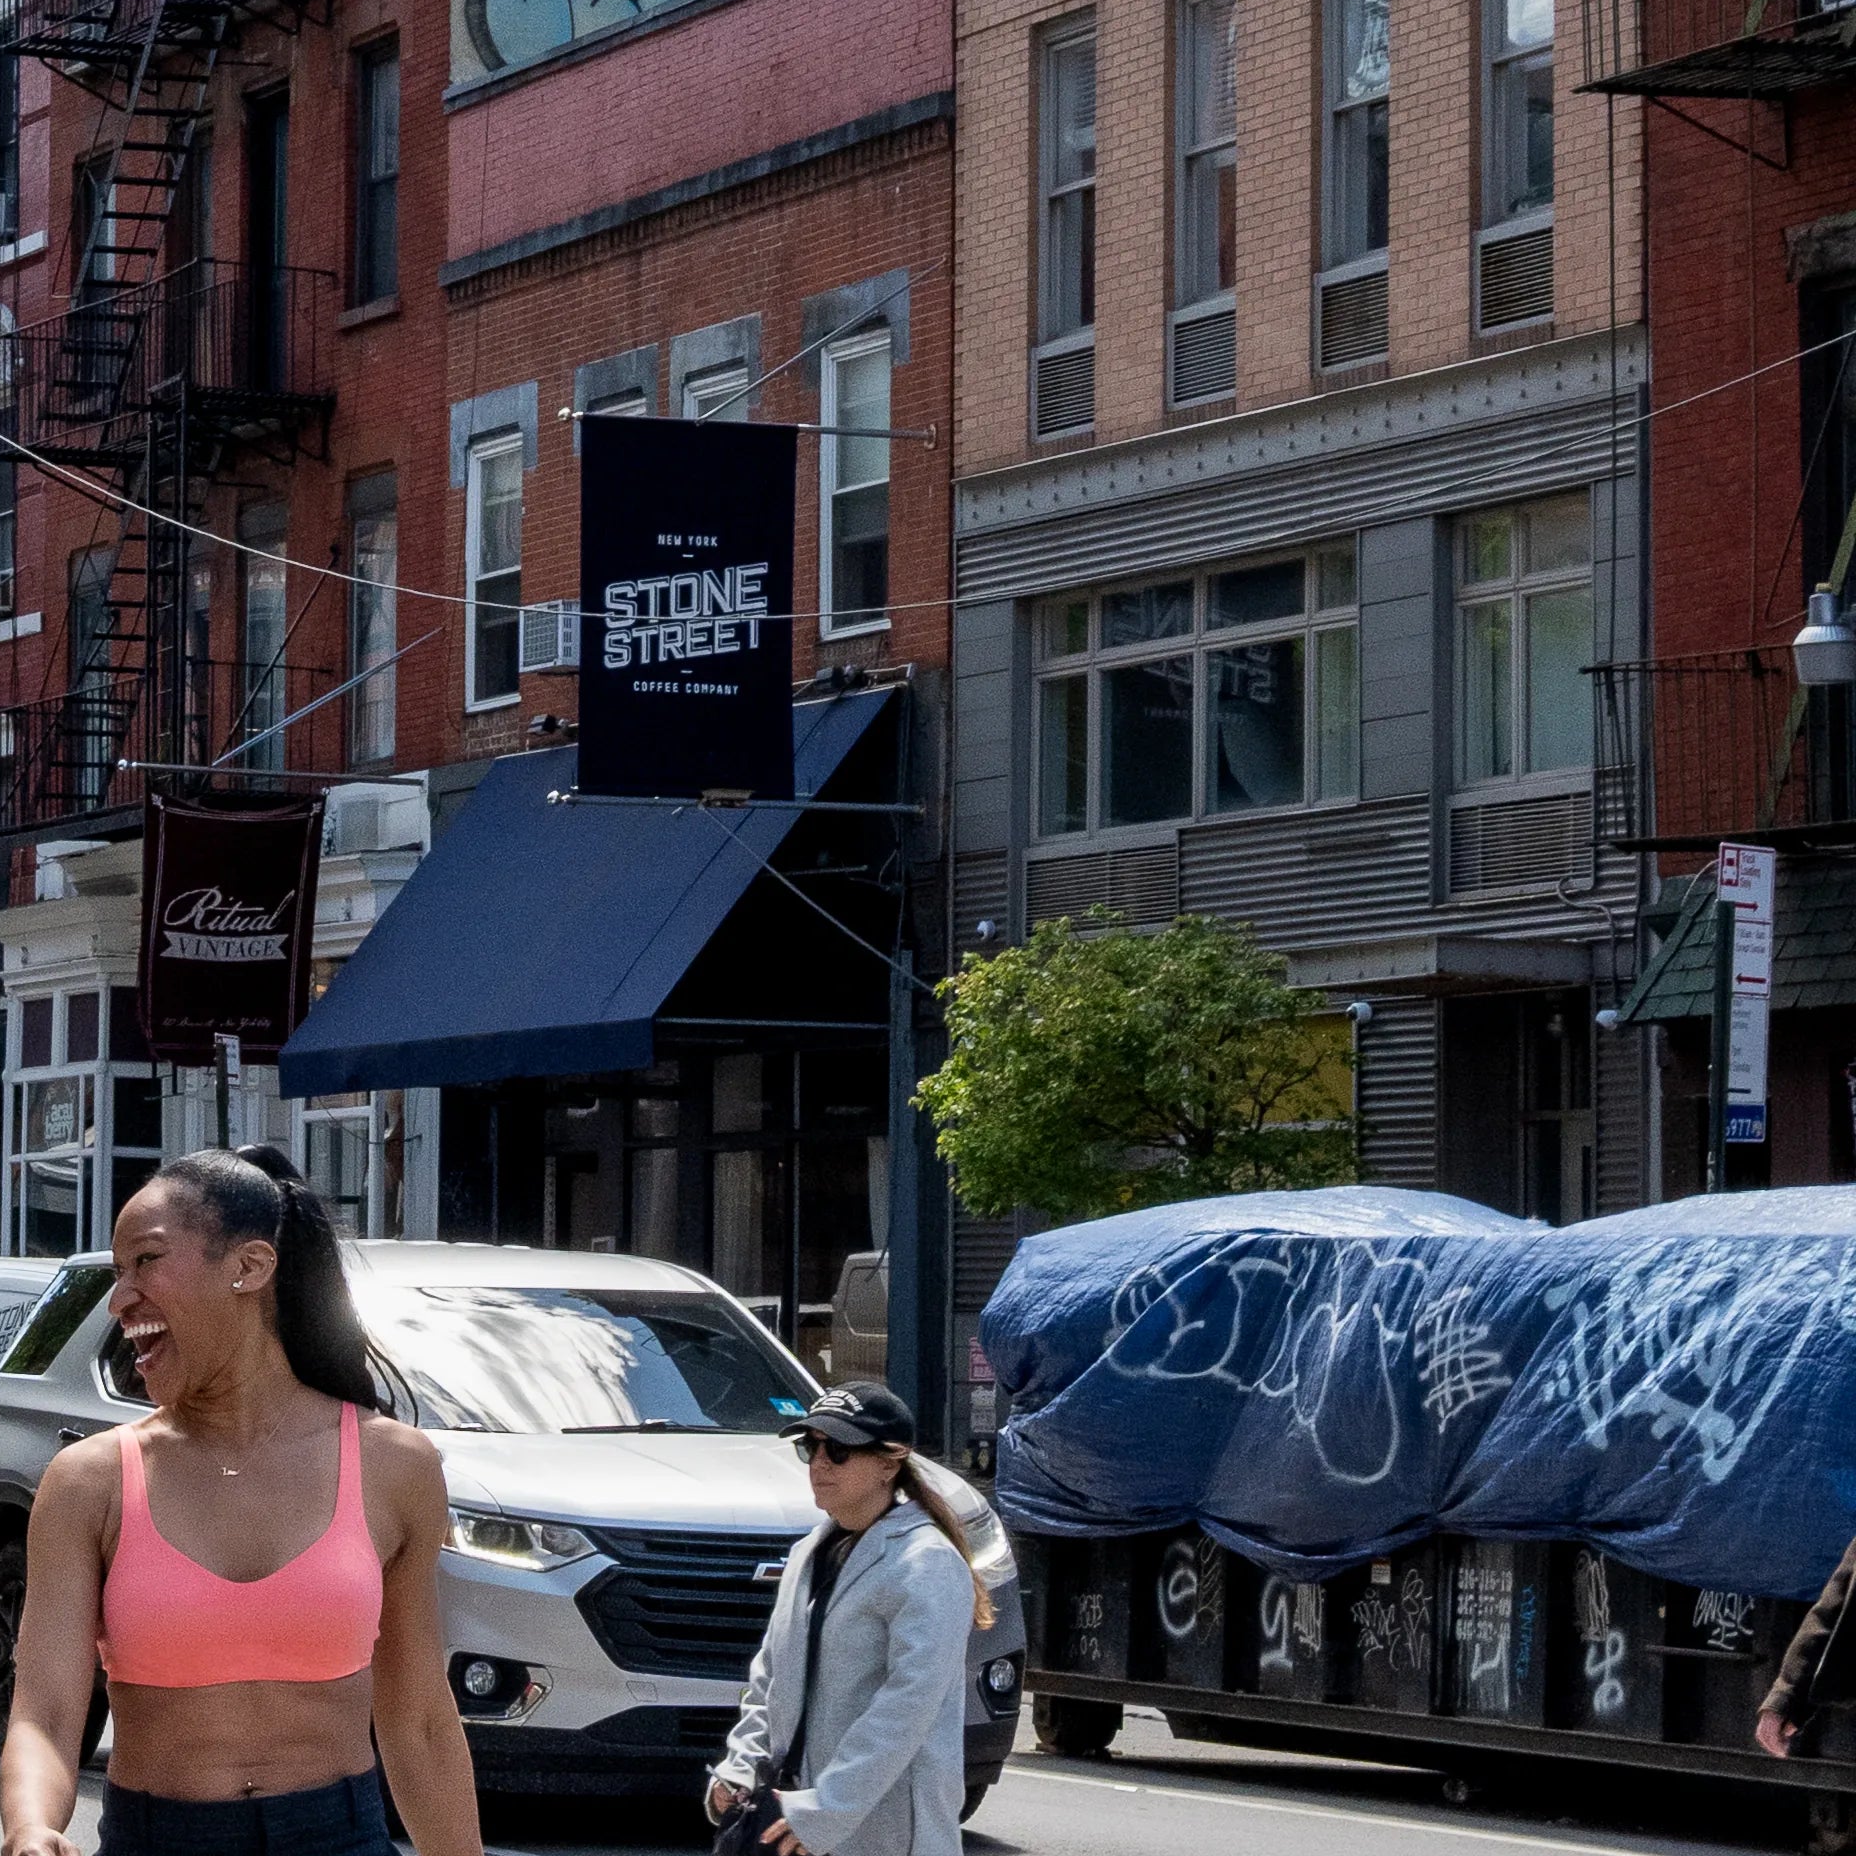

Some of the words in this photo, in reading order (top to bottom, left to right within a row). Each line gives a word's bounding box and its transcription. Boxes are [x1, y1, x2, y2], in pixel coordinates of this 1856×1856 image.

[657, 533, 682, 546] NEW
[687, 535, 719, 547] YORK
[604, 561, 769, 629] STONE
[603, 609, 768, 670] STREET
[633, 680, 679, 693] COFFEE
[685, 683, 740, 695] COMPANY
[163, 885, 296, 932] Ritual
[178, 937, 275, 958] VINTAGE
